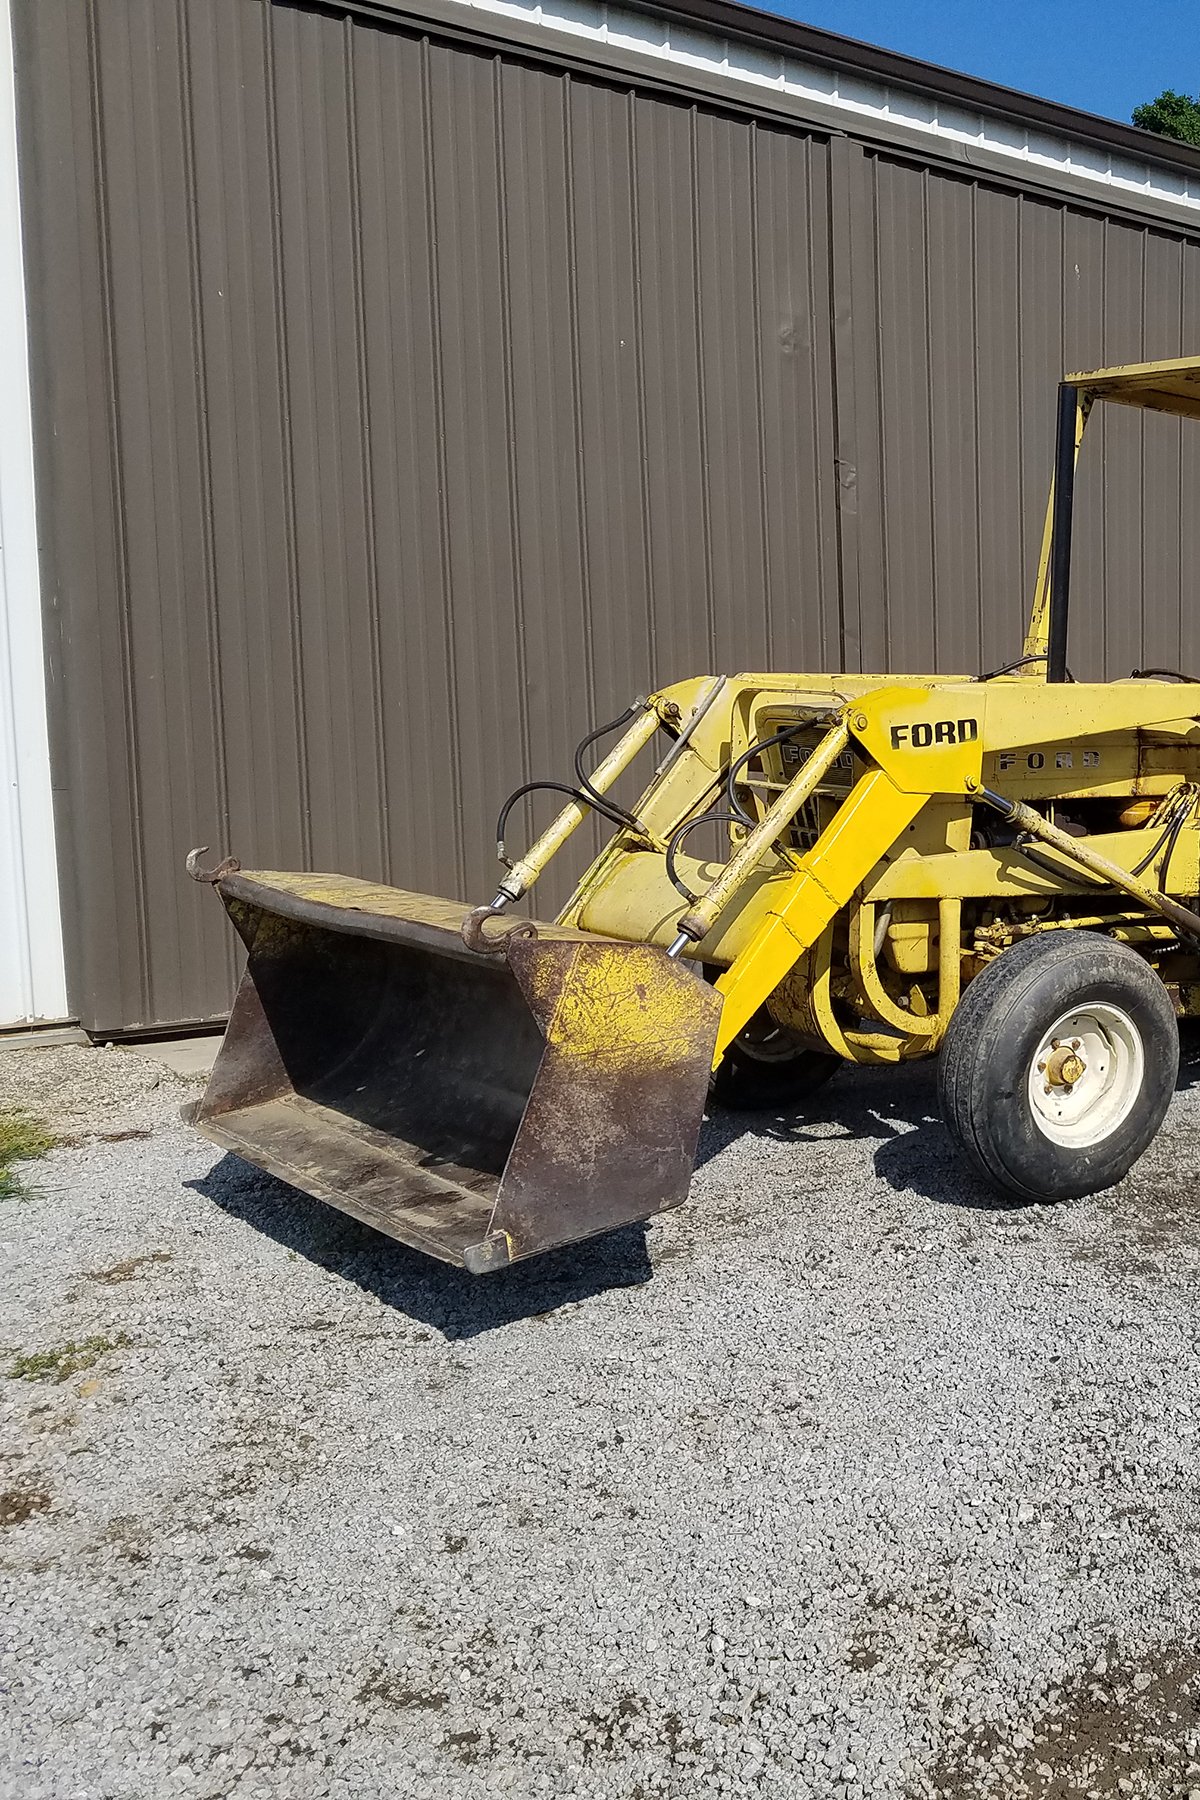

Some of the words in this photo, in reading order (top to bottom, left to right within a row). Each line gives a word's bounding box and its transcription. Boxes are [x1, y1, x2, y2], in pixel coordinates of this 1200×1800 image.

[890, 718, 978, 750] FORD
[781, 744, 853, 769] FOD
[999, 751, 1101, 771] FORD
